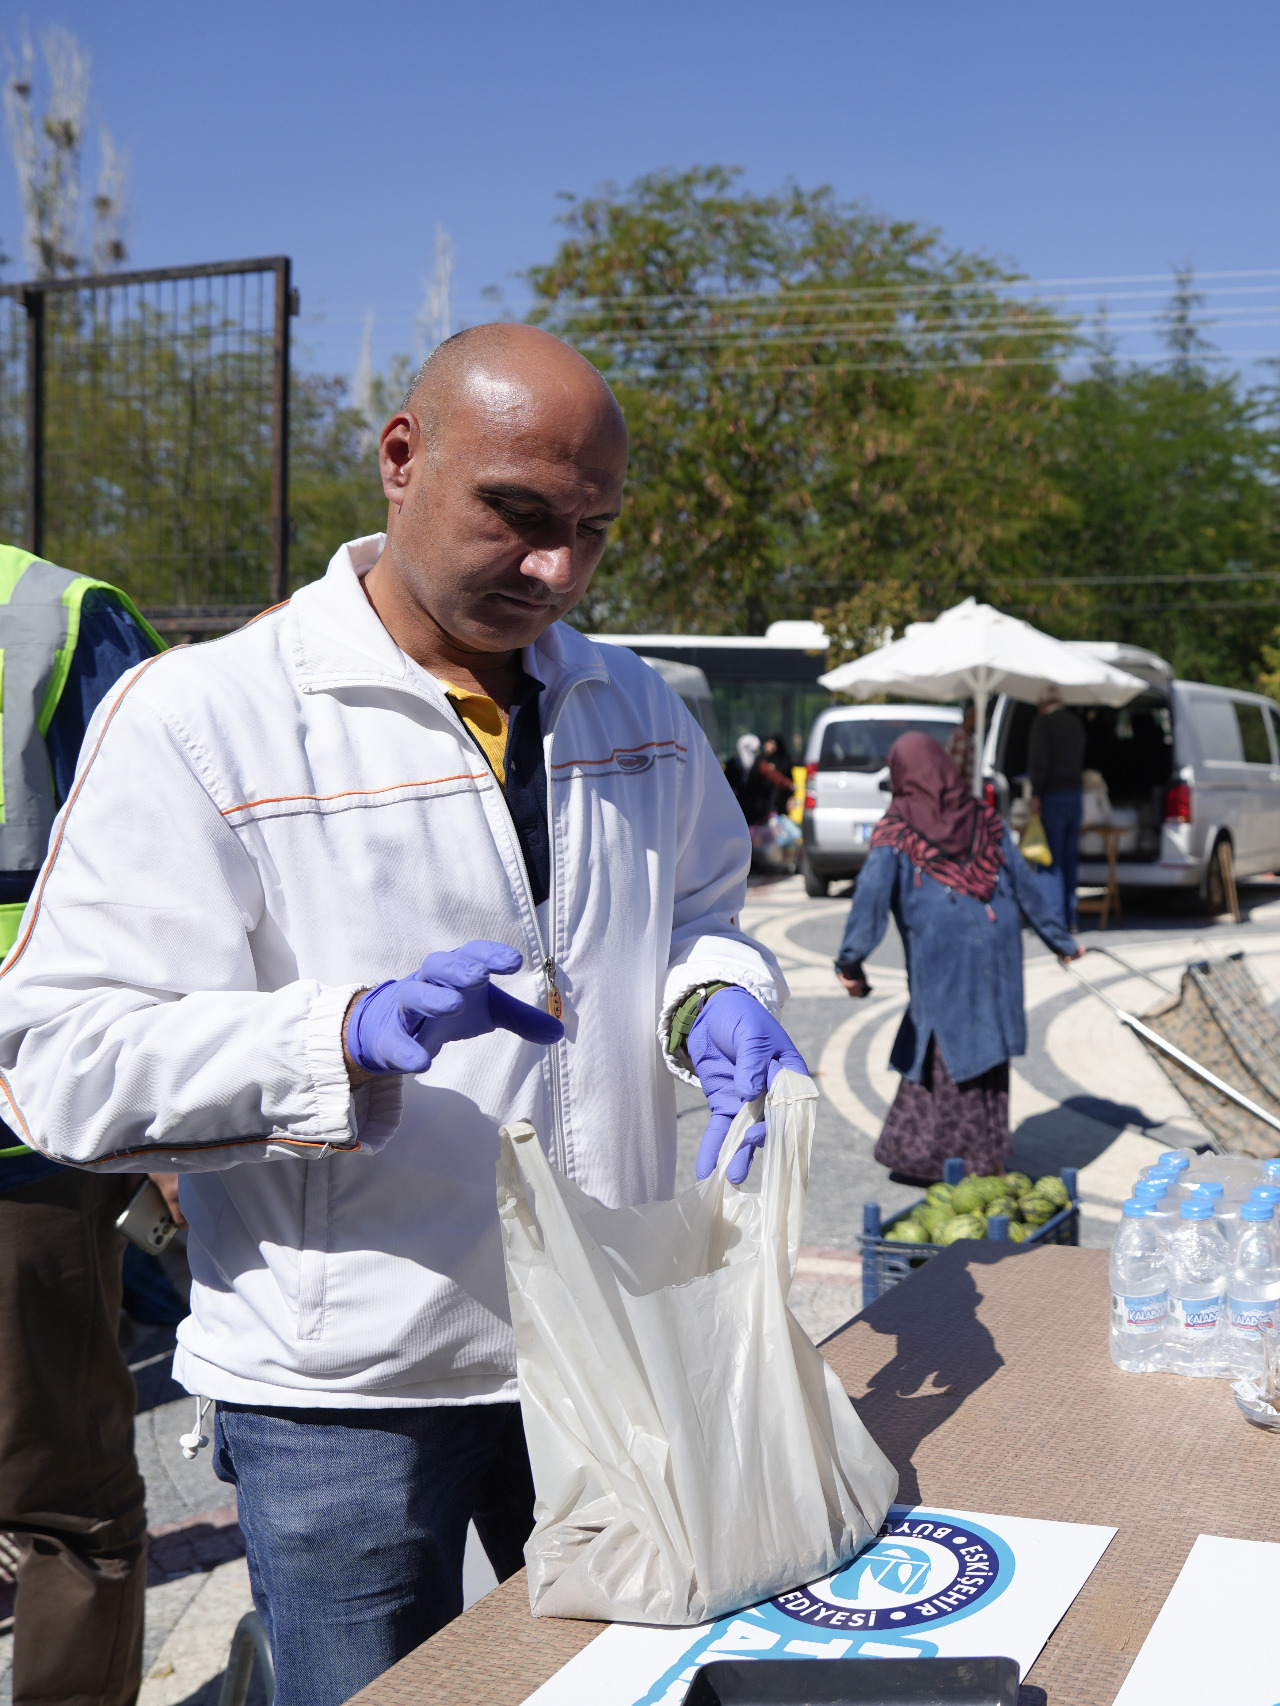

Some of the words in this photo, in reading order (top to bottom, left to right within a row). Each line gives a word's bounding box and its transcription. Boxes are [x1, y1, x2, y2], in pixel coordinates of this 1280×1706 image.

[877, 1521, 952, 1539] BÜYÜ
[914, 1544, 994, 1617] ESKİŞEHİR
[777, 1591, 877, 1627] EDİYESİ
